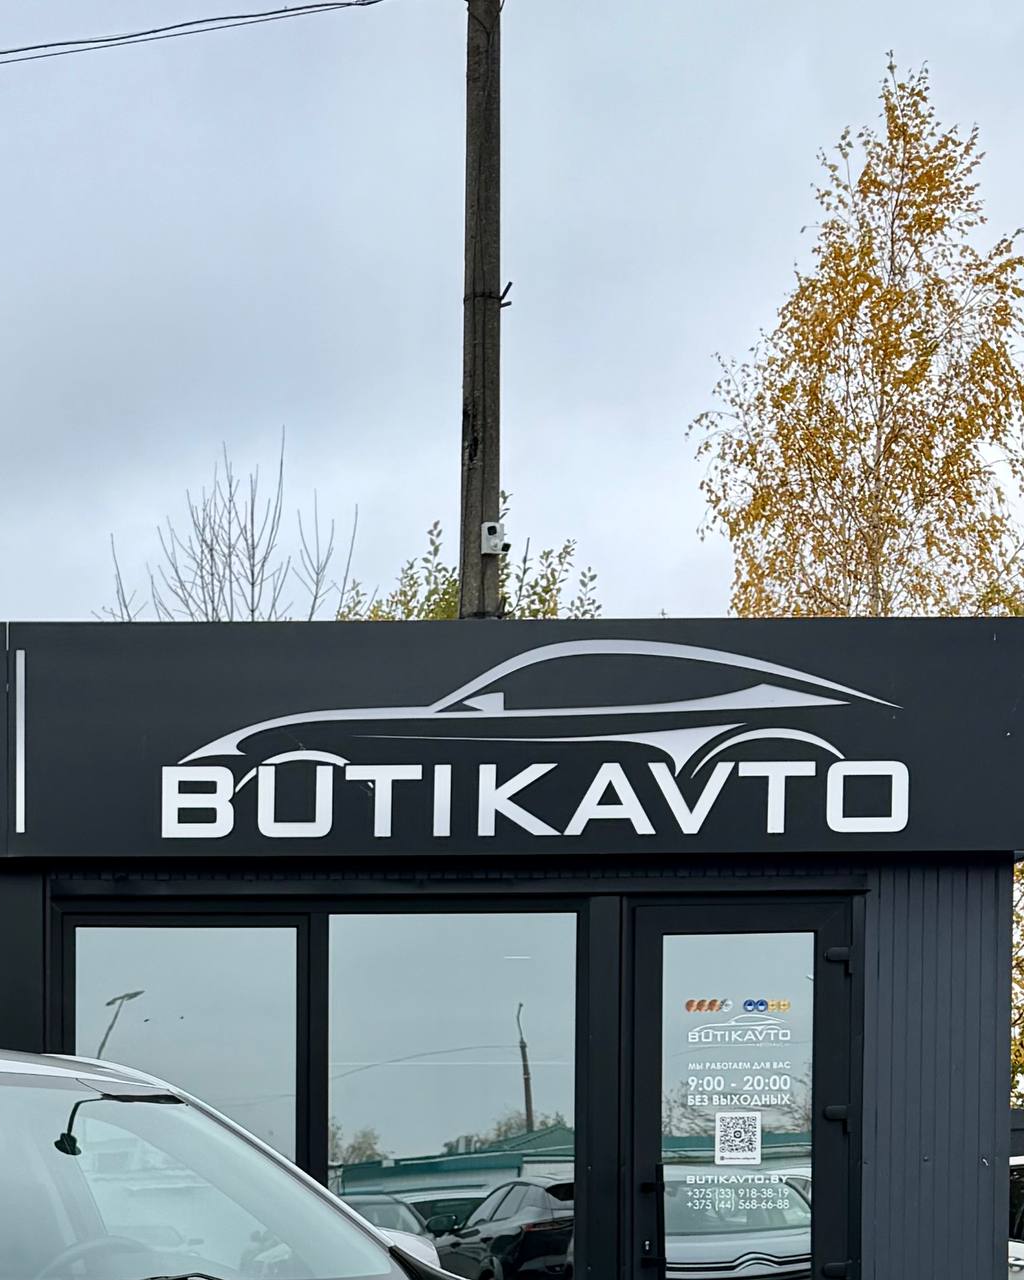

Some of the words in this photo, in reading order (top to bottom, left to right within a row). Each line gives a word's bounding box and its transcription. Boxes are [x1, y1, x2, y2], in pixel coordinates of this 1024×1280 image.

[161, 760, 910, 838] BUTIKAVTO
[688, 1030, 791, 1042] BUTIKAVTO
[688, 1062, 703, 1070] МЫ
[705, 1062, 751, 1070] РАБОТАЕМ
[772, 1061, 792, 1069] ВАС
[688, 1076, 725, 1091] 9:00
[742, 1075, 791, 1091] 20:00
[687, 1094, 709, 1105] БЕЗ
[712, 1094, 791, 1106] ВЫХОДНЫХ
[687, 1175, 788, 1184] BUTIKAVTO.BY
[687, 1188, 712, 1198] +375
[715, 1188, 735, 1199] (33)
[738, 1188, 789, 1198] 918-38-19
[687, 1199, 712, 1209] +375
[715, 1199, 735, 1211] (44)
[738, 1199, 790, 1209] 568-66-88
